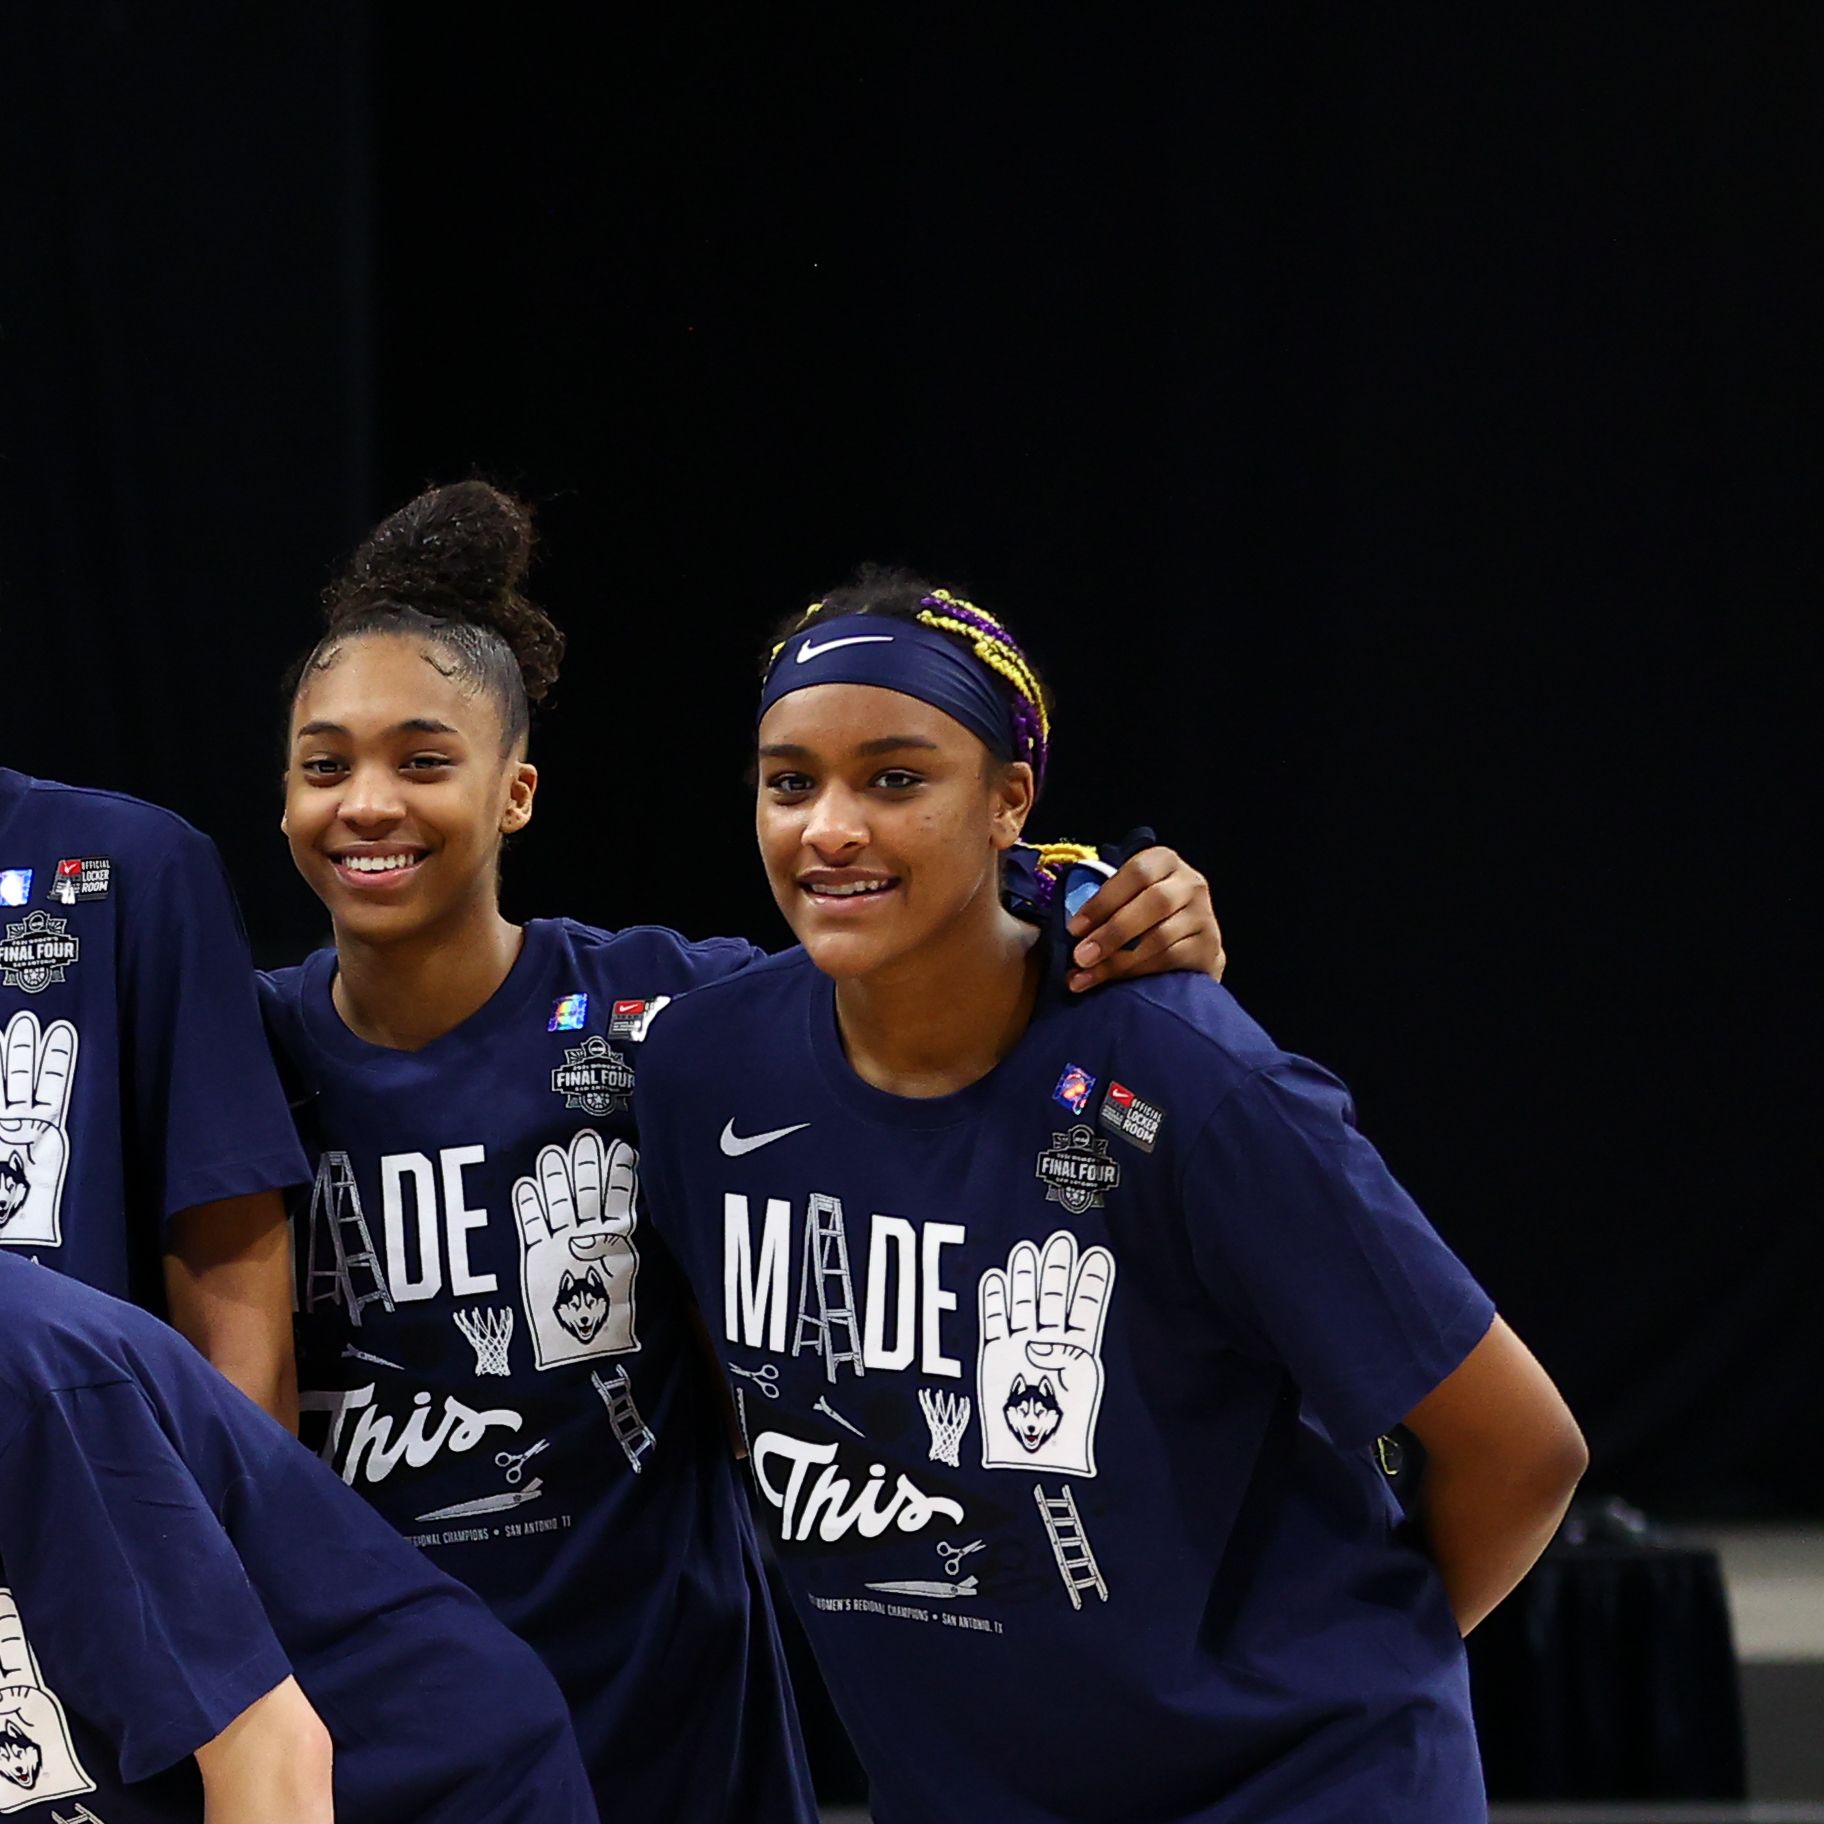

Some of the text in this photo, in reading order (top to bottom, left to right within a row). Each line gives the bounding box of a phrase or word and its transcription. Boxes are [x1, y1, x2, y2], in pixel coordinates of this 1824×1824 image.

[81, 860, 110, 870] OFFICIAL
[81, 869, 109, 881] LOCKER
[81, 881, 108, 893] ROOM
[36, 942, 75, 958] FOUR
[556, 1069, 599, 1087] FINAL
[1126, 1108, 1159, 1134] LOCKER
[1131, 1098, 1162, 1123] OFFICIAL
[1122, 1119, 1155, 1144] ROOM
[1042, 1157, 1077, 1179] FINAL
[305, 1143, 498, 1328] ADE
[723, 1192, 965, 1384] MADE
[753, 1431, 964, 1542] This
[442, 1527, 490, 1545] CHAMPIONS
[504, 1522, 522, 1538] SAN
[853, 1598, 886, 1615] REGIONAL
[887, 1604, 930, 1622] CHAMPIONS
[941, 1612, 959, 1627] SAN
[994, 1620, 1004, 1635] TX
